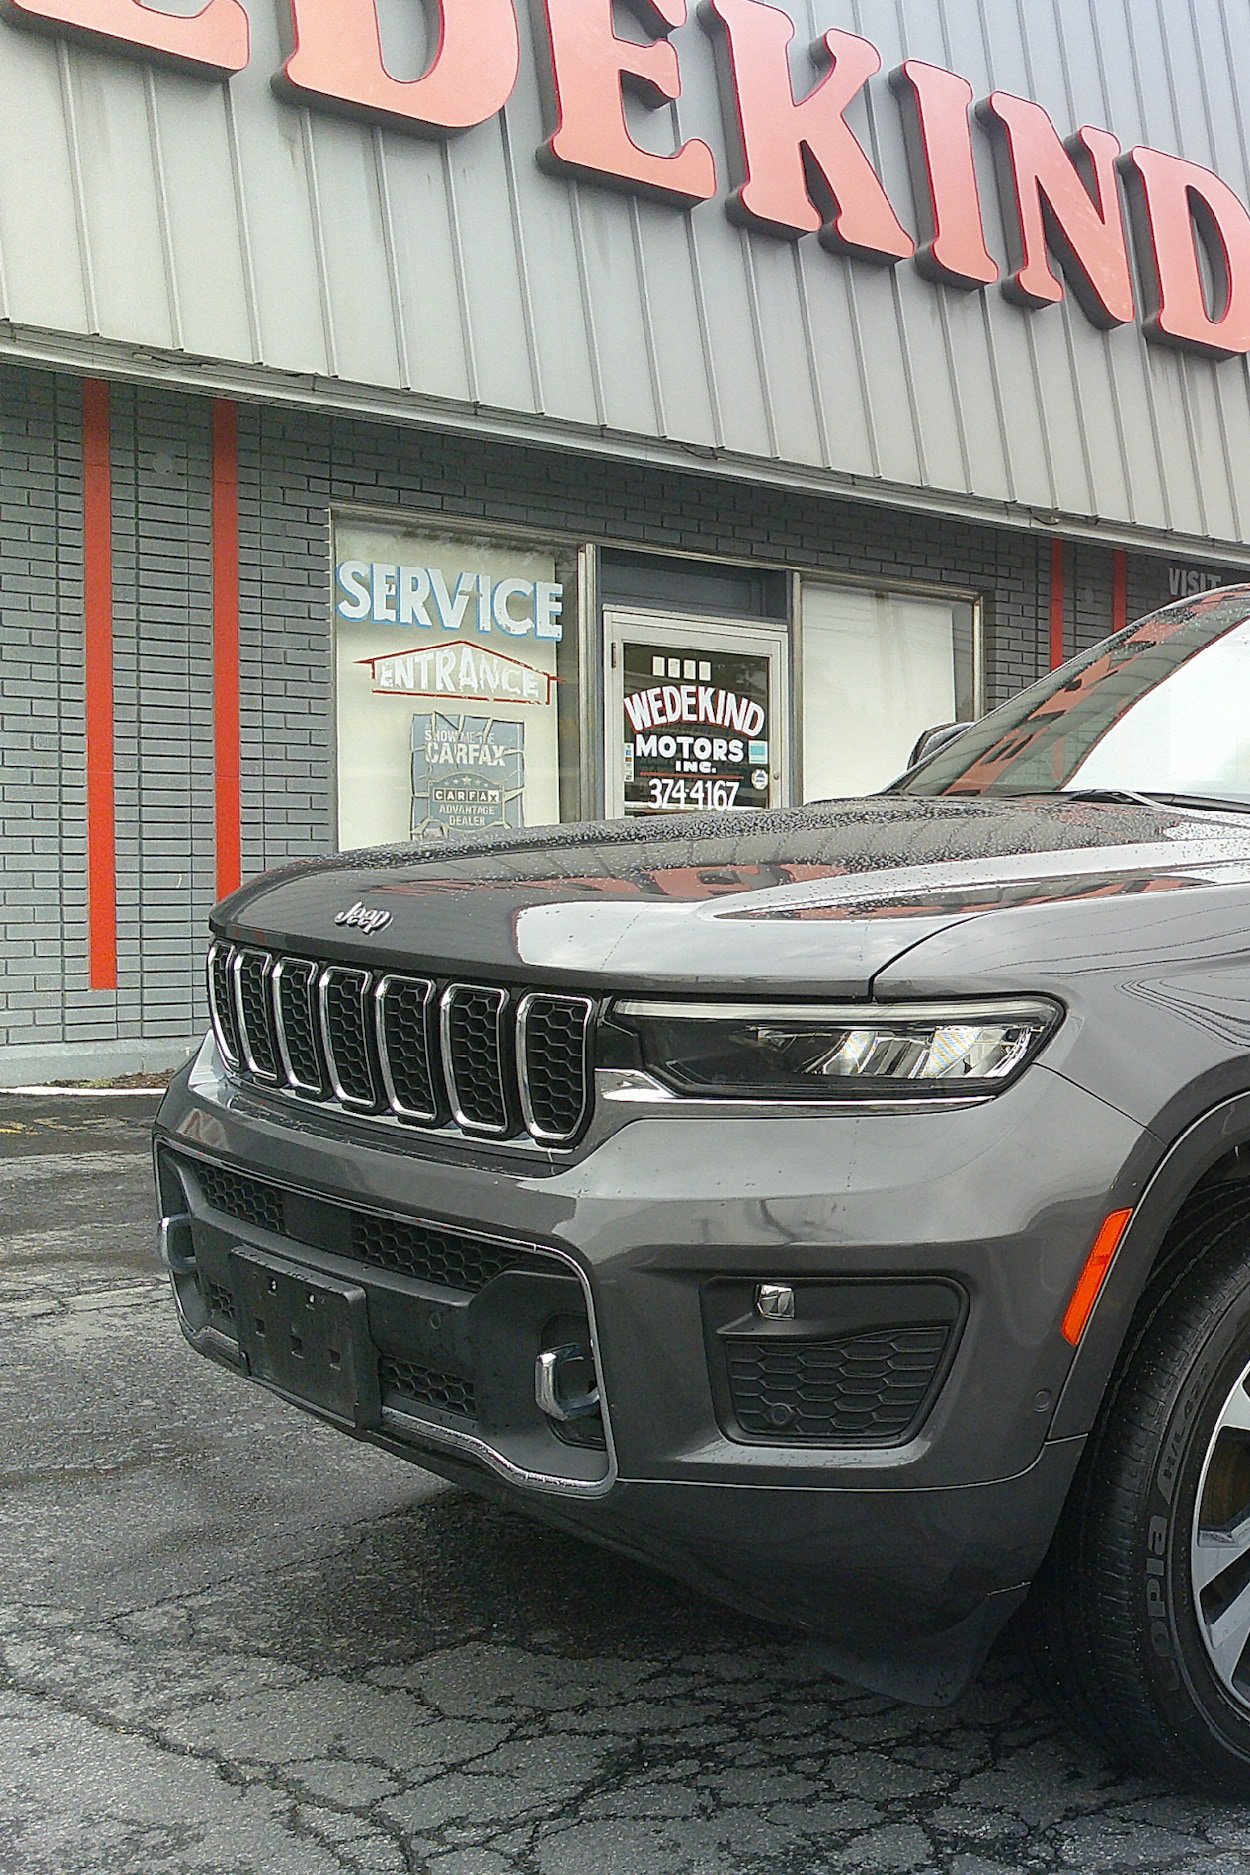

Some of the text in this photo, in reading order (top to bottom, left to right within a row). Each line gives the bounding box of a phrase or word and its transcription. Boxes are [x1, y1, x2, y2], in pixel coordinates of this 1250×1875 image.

[1168, 567, 1222, 597] VISIT
[336, 560, 563, 641] SERVICE
[379, 646, 539, 698] ENTRANCE
[624, 685, 765, 738] WEDEKIND
[425, 742, 506, 767] CARFAX
[635, 733, 744, 762] MOTORS
[675, 761, 717, 773] INC.
[434, 789, 499, 802] CARFAX
[439, 803, 495, 815] ADVANTAGE
[648, 778, 740, 811] 374-4167
[449, 815, 486, 826] DEALER
[334, 900, 391, 934] Jeep
